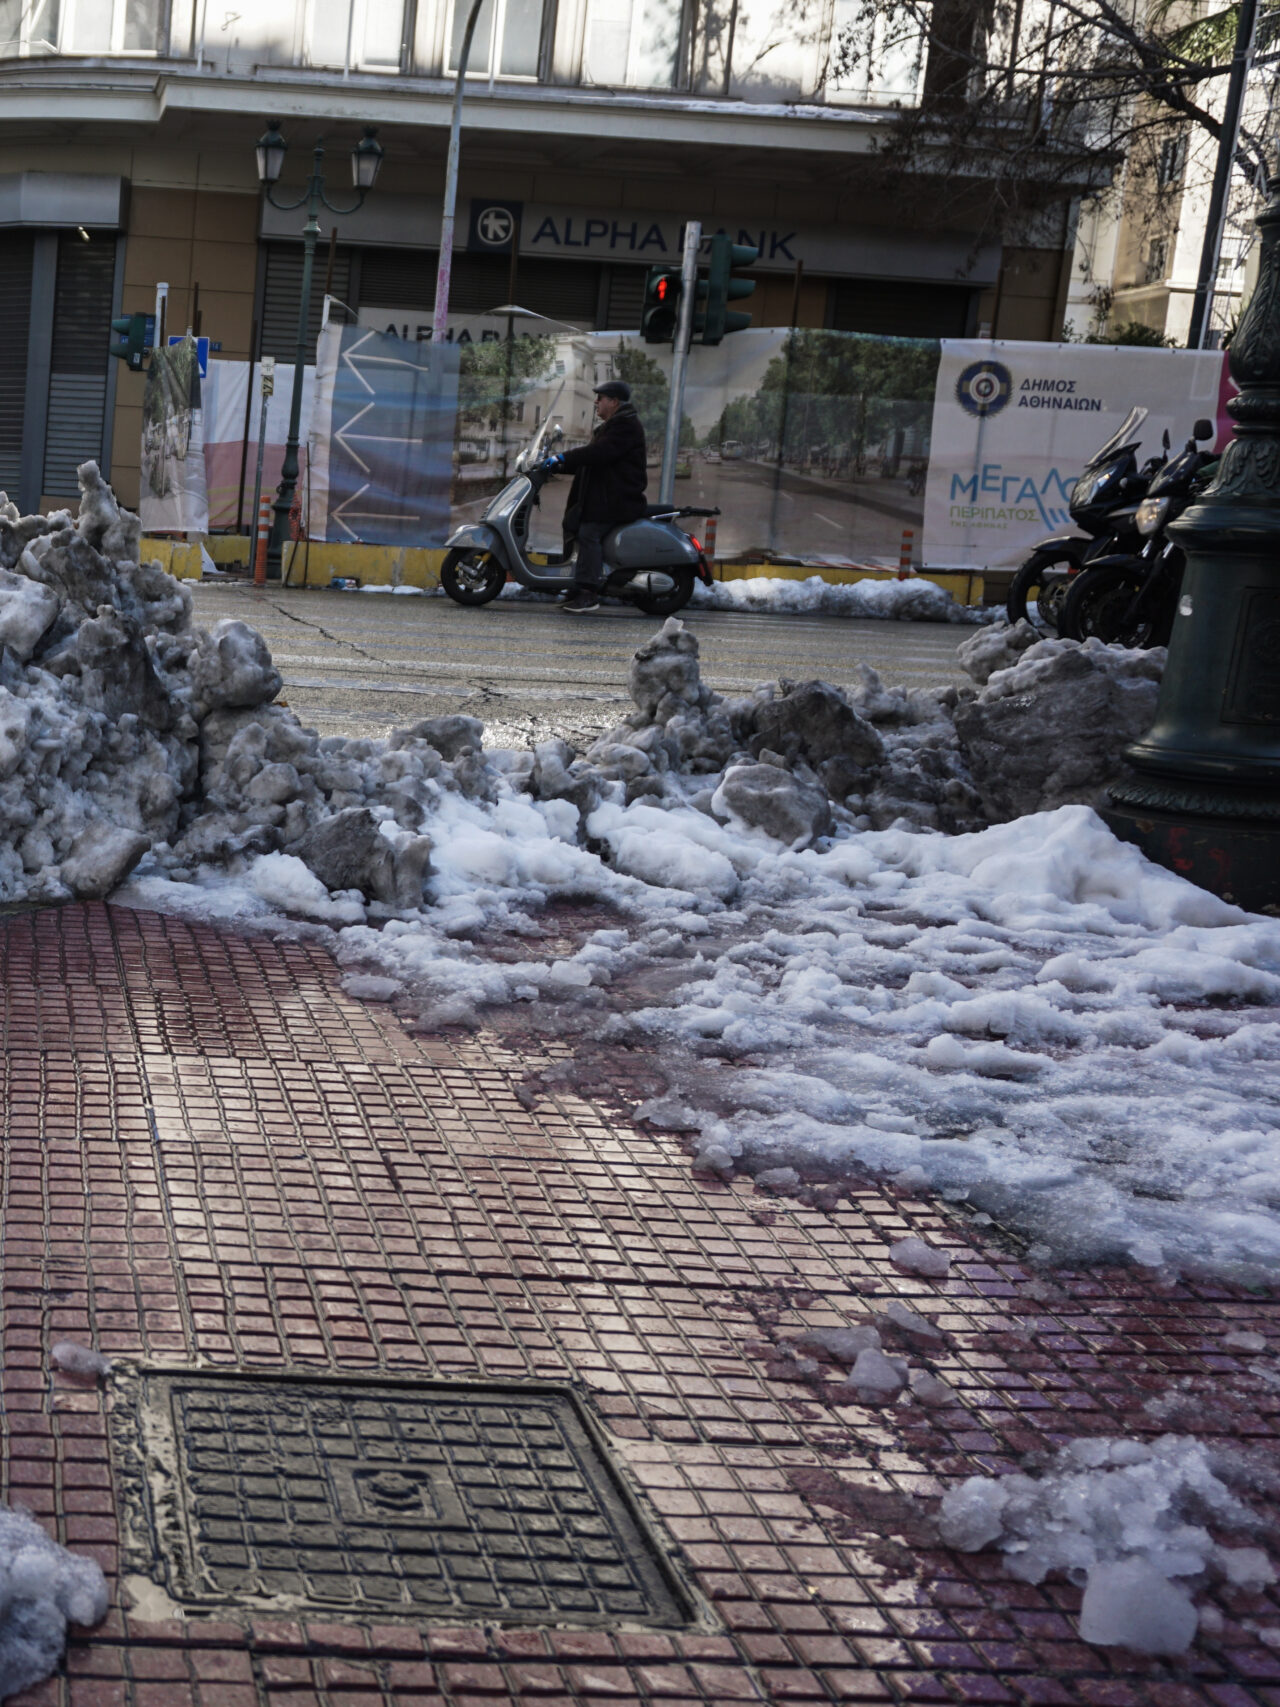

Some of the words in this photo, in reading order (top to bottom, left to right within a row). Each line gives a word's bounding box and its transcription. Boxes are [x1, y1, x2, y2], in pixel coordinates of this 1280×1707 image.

[531, 216, 667, 252] ALPHA
[1020, 378, 1076, 393] ΔΗΜΟΣ
[1018, 395, 1102, 412] ΑΘΗΝΑΙΩΝ
[949, 505, 1040, 522] ΠΕΡΙΠΑΤΟΣ
